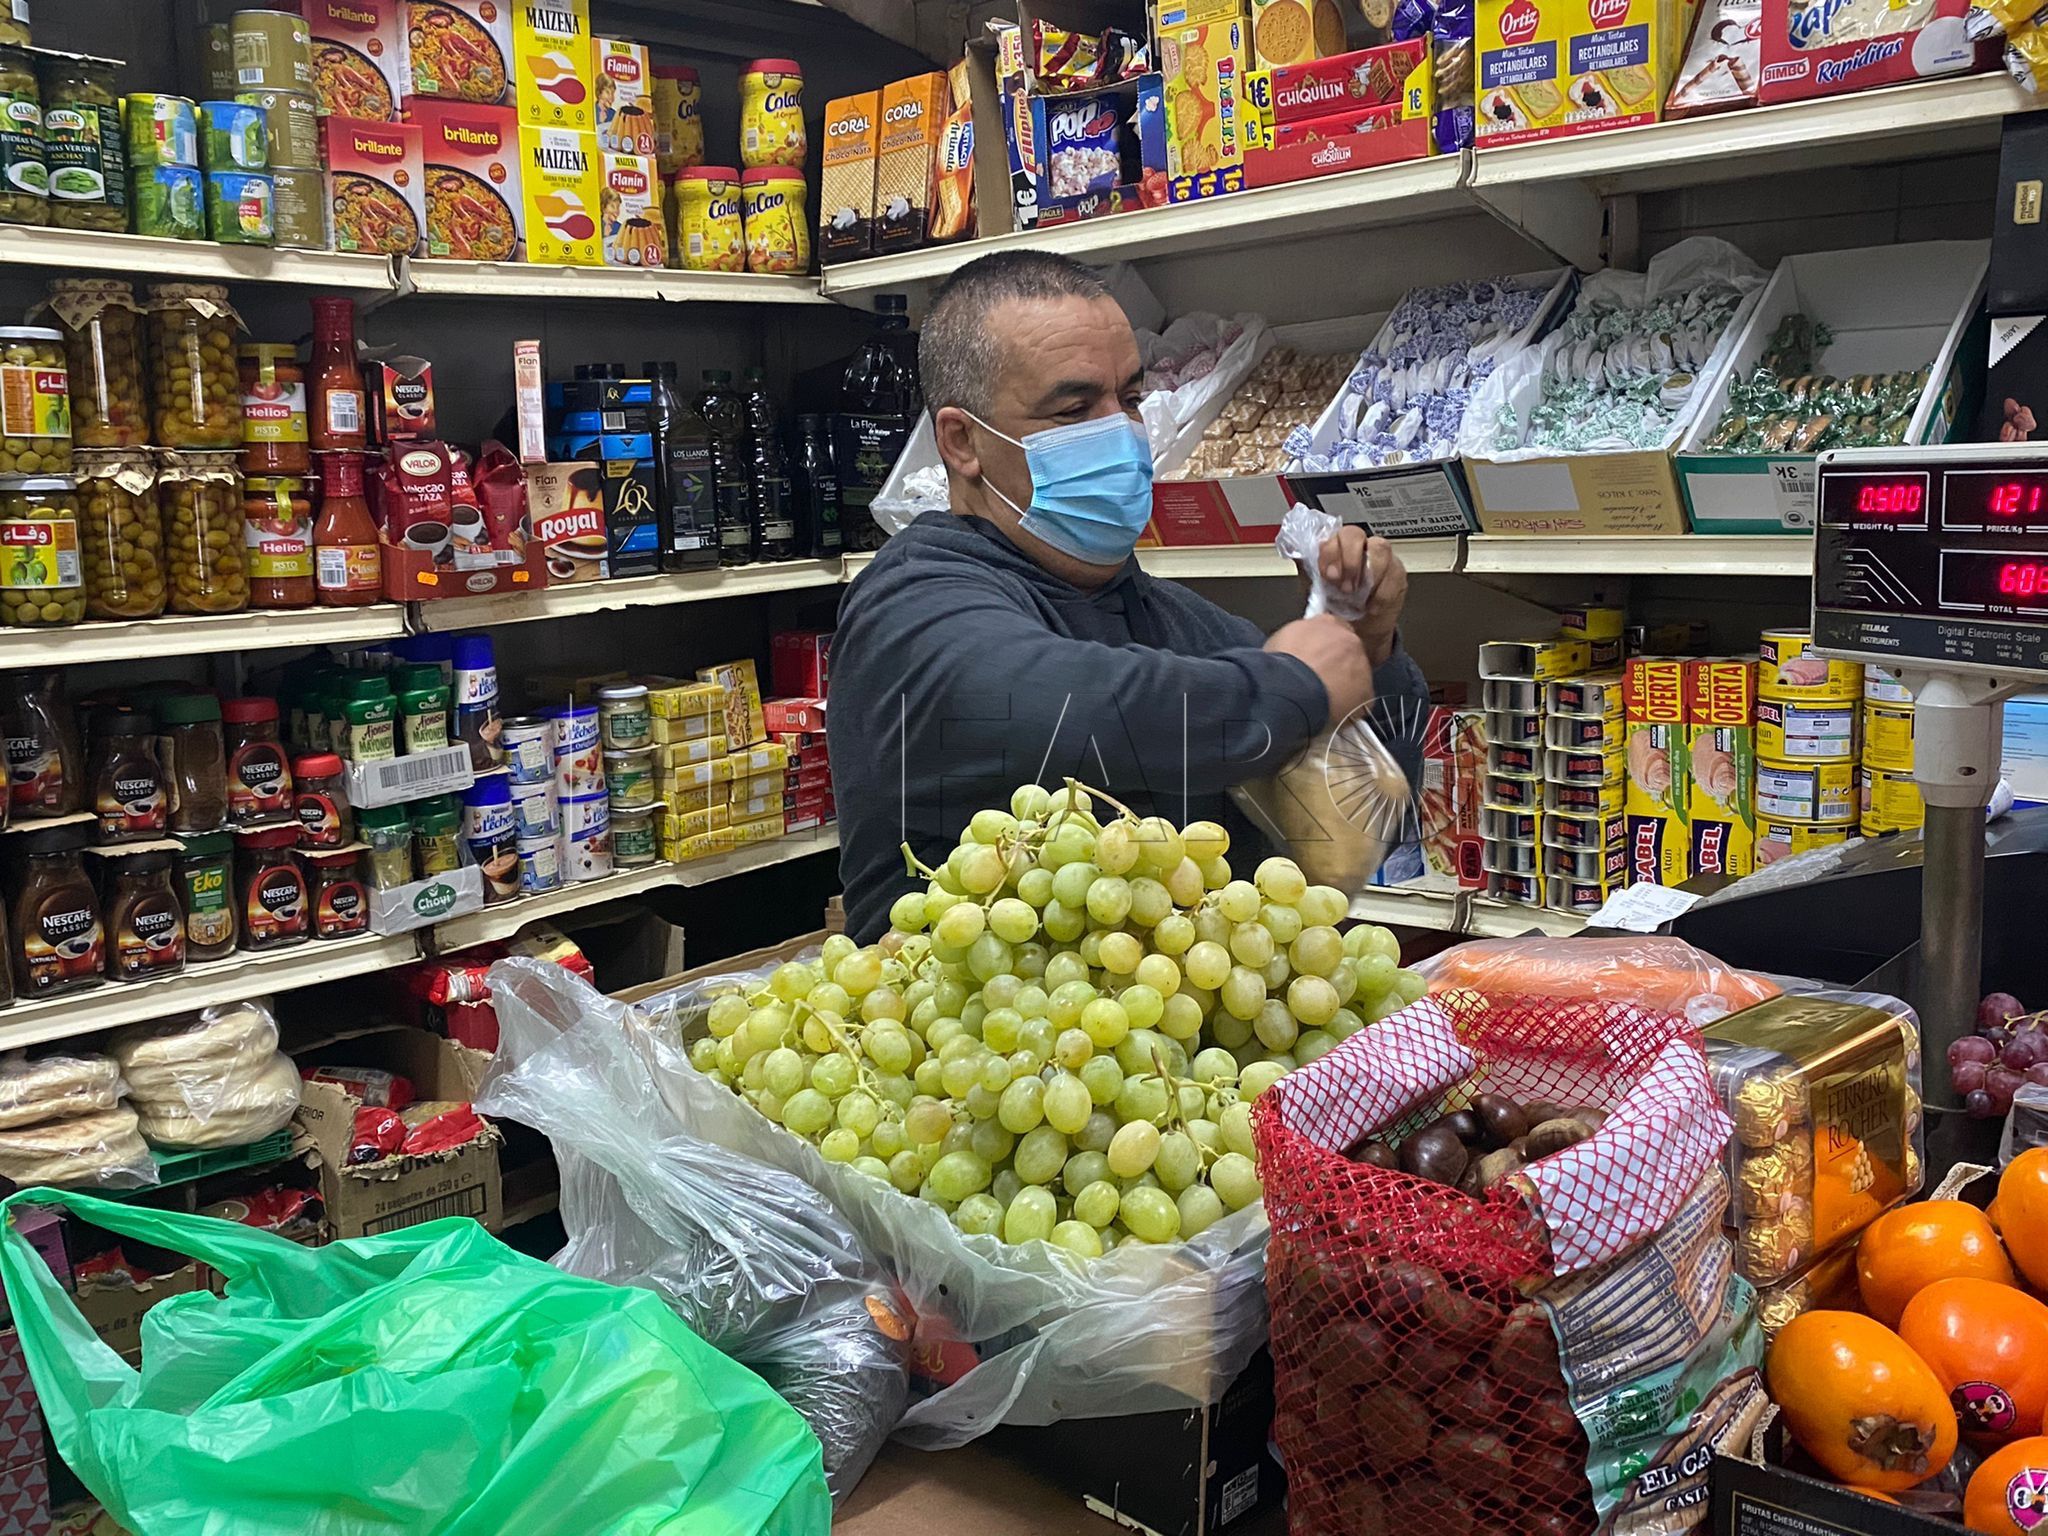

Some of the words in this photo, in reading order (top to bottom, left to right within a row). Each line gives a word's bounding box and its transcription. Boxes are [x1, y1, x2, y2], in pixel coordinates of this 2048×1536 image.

[328, 4, 376, 24] brillante
[525, 6, 581, 35] MAIZENA
[1501, 8, 1537, 35] Ortiz
[1579, 39, 1639, 61] RECTANGULARES
[1490, 55, 1548, 76] RECTANGULARES
[1589, 57, 1628, 71] RETANGULARES
[1816, 38, 1904, 84] Rapiditas
[1500, 71, 1537, 85] RETANGULARES
[1764, 64, 1807, 82] BIMBO
[1248, 77, 1270, 107] 1€
[1409, 87, 1422, 111] 1€
[884, 100, 923, 123] CORAL
[1216, 57, 1236, 157] Dinosaurus
[444, 126, 498, 145] brillante
[829, 116, 871, 138] CORAL
[1245, 121, 1258, 142] 1€
[354, 138, 403, 156] brillante
[640, 136, 650, 149] 24
[533, 147, 589, 172] MAIZENA
[1015, 188, 1039, 225] 1€
[647, 247, 657, 259] 24
[2000, 324, 2020, 343] LARGE
[518, 357, 538, 366] Flan
[245, 407, 289, 418] Helios
[254, 425, 281, 434] PISTO
[861, 420, 877, 430] Flor
[672, 450, 686, 458] LOS
[686, 449, 710, 458] LLANOS
[405, 459, 437, 469] VALOR
[535, 475, 558, 486] Flan
[418, 492, 443, 503] TAZA
[540, 511, 599, 542] Royal
[1369, 517, 1419, 529] ALMENDRA
[1428, 514, 1463, 525] ACEITE
[1852, 523, 1883, 531] WEIGHT
[1883, 523, 1894, 533] Kg
[1387, 523, 1465, 536] POLVORONCITOS
[1986, 525, 2023, 535] PRICE/Kg
[263, 542, 304, 553] Helios
[272, 560, 299, 570] PISTO
[1988, 605, 2014, 614] TOTAL
[1860, 636, 1900, 647] INSTRUMENTS
[1937, 625, 1966, 638] Digital
[1967, 627, 2012, 641] Electronic
[2015, 631, 2041, 644] Scale
[1631, 664, 1644, 701] Latas
[1651, 663, 1679, 720] OFERTA
[1696, 664, 1709, 702] Latas
[1714, 664, 1744, 721] OFERTA
[1627, 704, 1645, 718] 4
[1692, 705, 1709, 719] 4
[1662, 848, 1673, 875] Atún
[193, 873, 223, 893] Eko
[417, 889, 451, 911] Choví
[48, 921, 90, 935] CLASSIC
[139, 921, 172, 932] CLASSIC
[1827, 1066, 1891, 1122] FERRERO
[1827, 1100, 1890, 1154] ROCHER
[375, 1202, 387, 1214] 24
[1642, 1466, 1677, 1495] EL
[1741, 1503, 1772, 1520] FRUTAS
[1772, 1514, 1804, 1530] CHESCO
